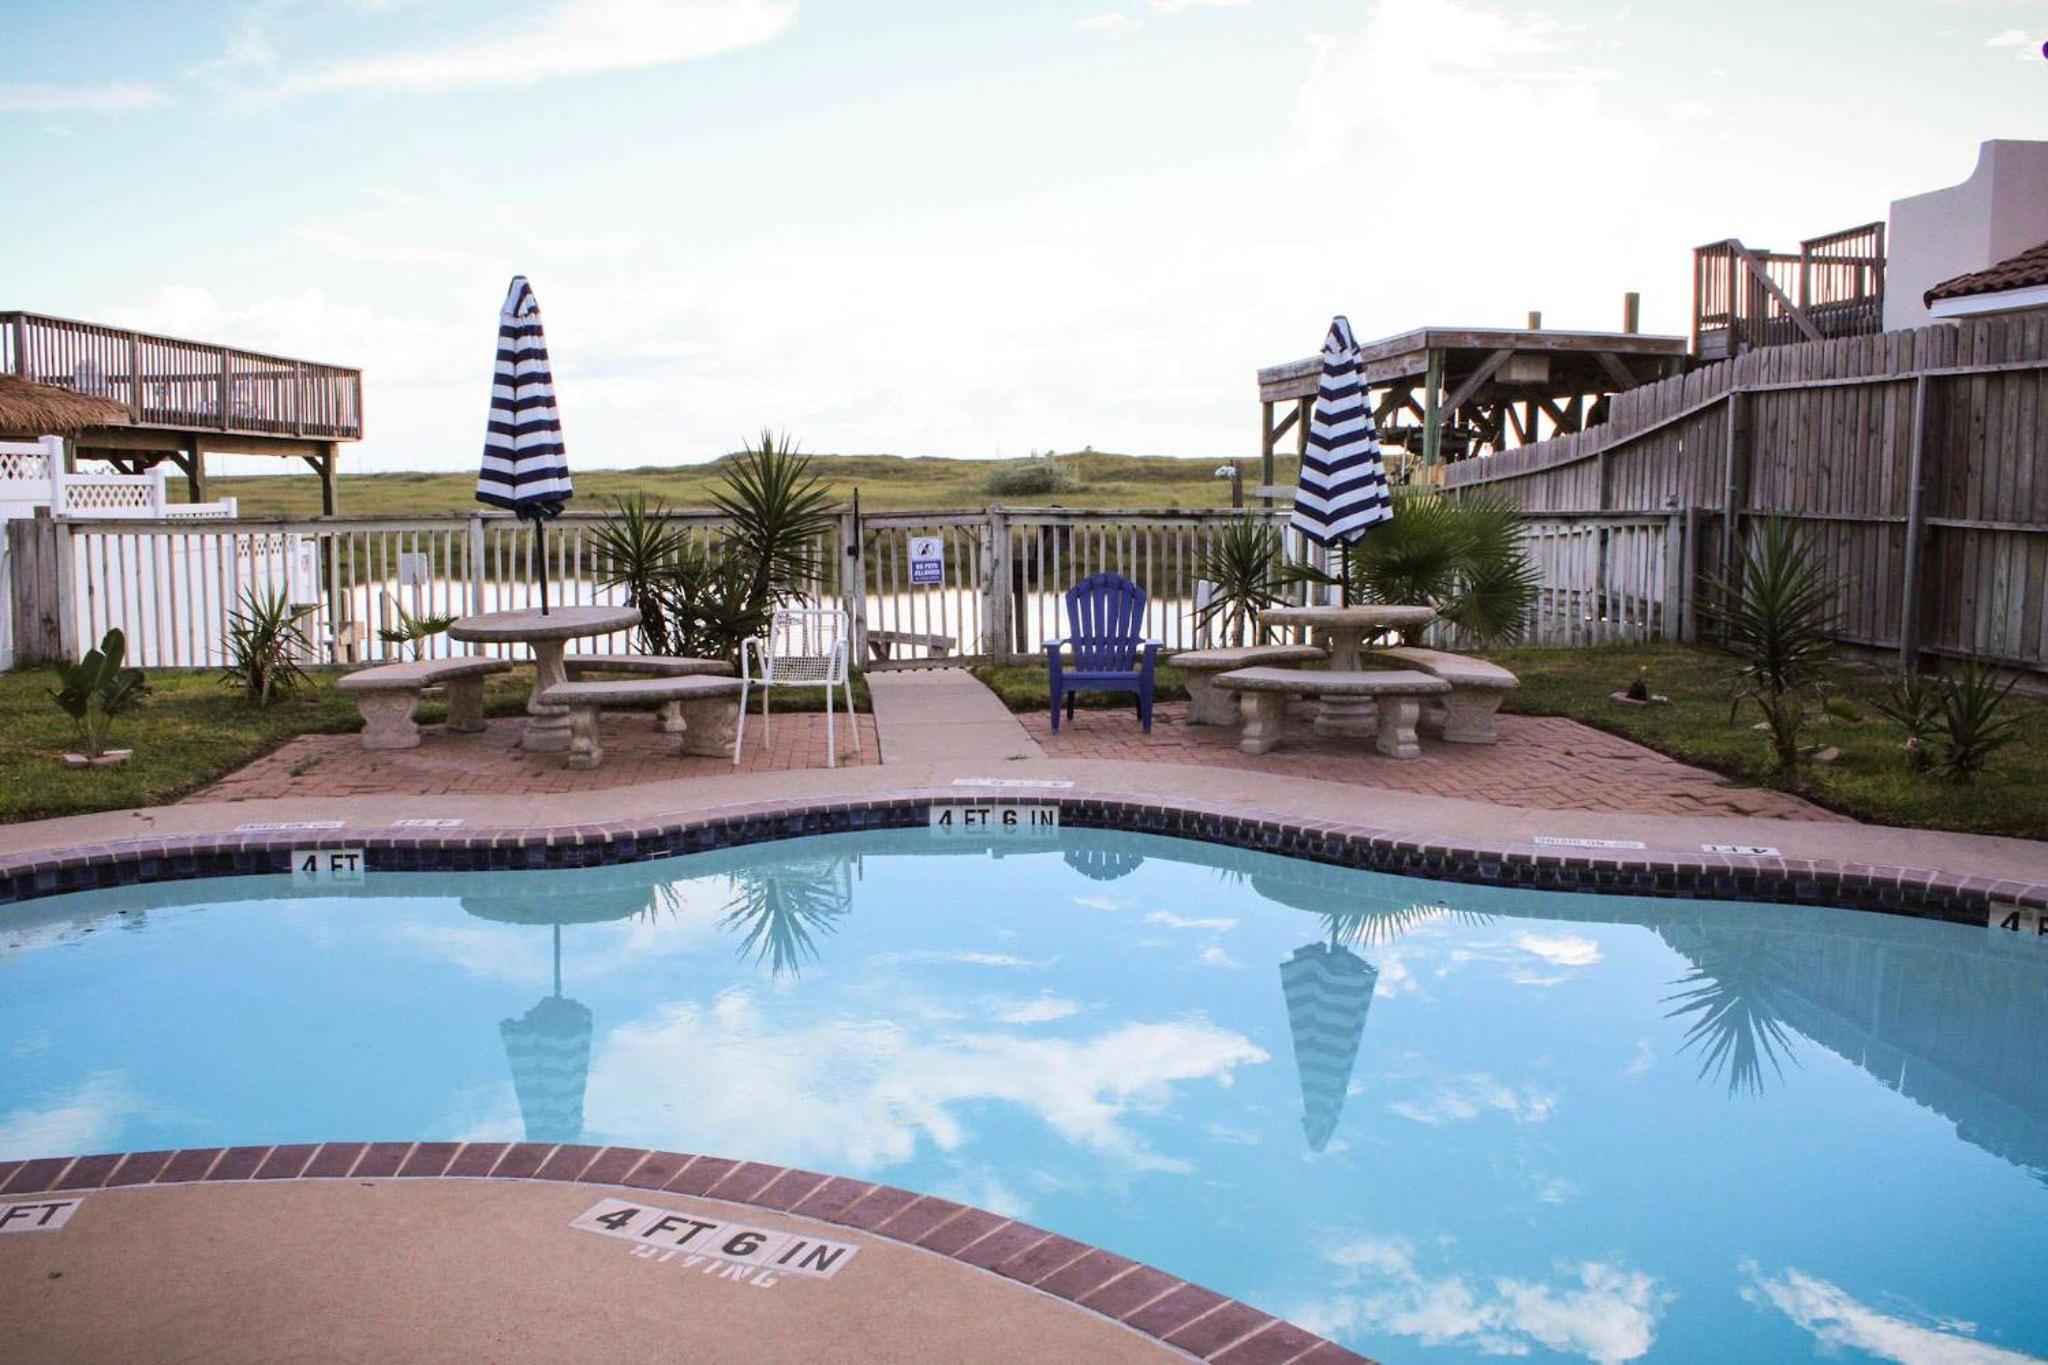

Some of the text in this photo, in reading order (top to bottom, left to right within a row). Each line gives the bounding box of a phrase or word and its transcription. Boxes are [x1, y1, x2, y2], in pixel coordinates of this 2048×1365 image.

[938, 809, 1054, 827] 4 FT 6 IN
[302, 854, 359, 872] 4 FT
[2000, 911, 2020, 932] 4
[0, 1202, 73, 1229] FT
[595, 1208, 847, 1273] 4 FT 6 IN
